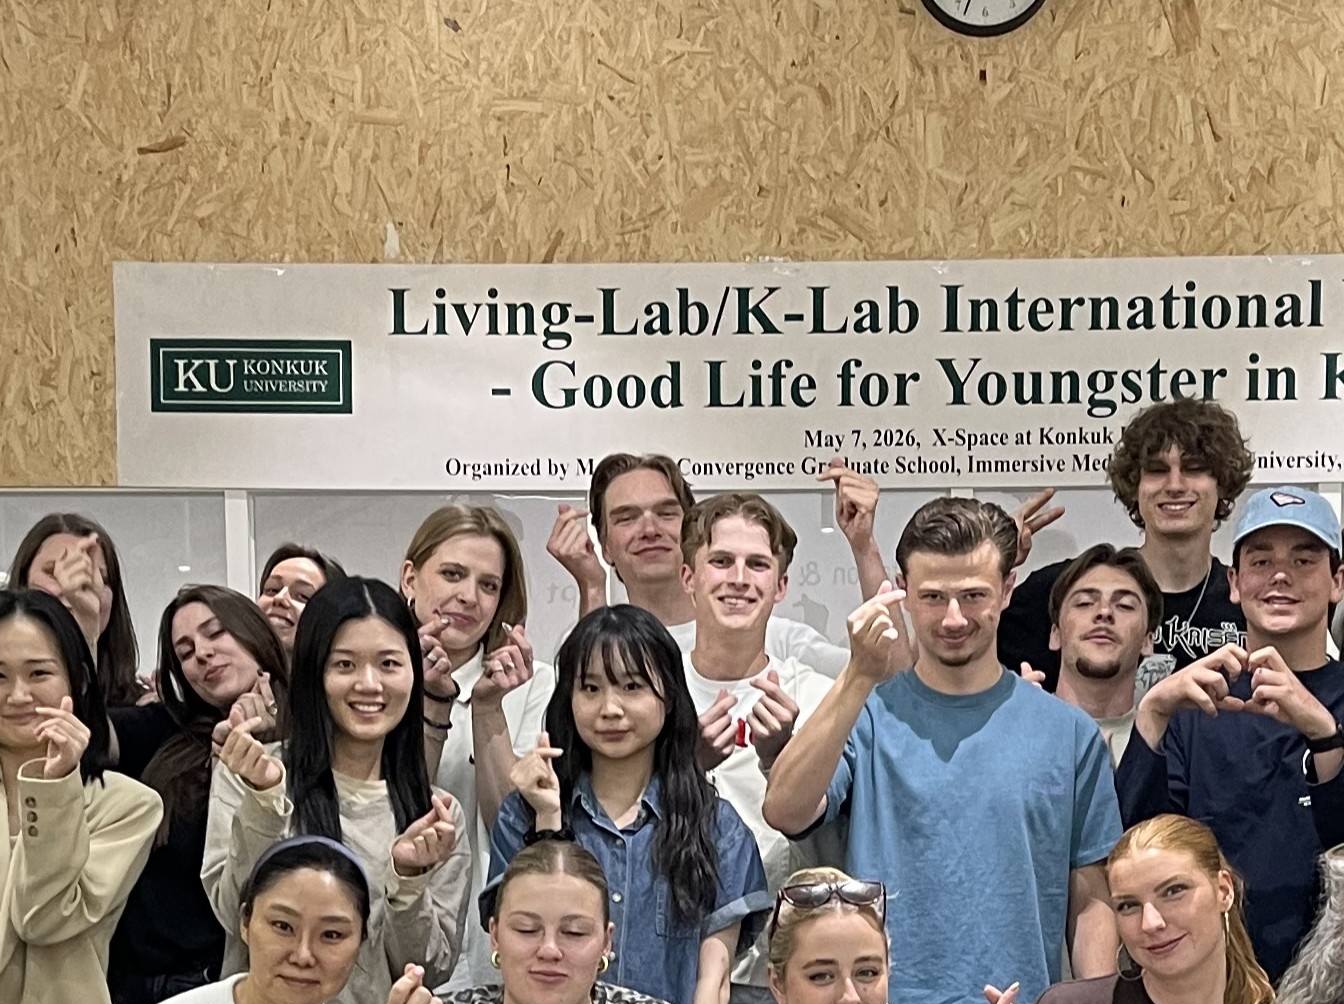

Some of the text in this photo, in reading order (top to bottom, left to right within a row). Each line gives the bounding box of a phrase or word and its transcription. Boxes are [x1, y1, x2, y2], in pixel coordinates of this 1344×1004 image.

[387, 285, 920, 350] Living-Lab/K-Lab
[939, 279, 1325, 333] International
[173, 359, 238, 393] KU
[243, 359, 328, 376] KONKUK
[243, 380, 328, 393] UNIVERSITY
[530, 358, 685, 409] Good
[703, 358, 818, 408] Life
[836, 358, 921, 407] for
[935, 356, 1228, 419] Youngster
[1244, 352, 1298, 402] in
[804, 429, 846, 452] May
[851, 429, 867, 450] 7,
[872, 428, 921, 450] 2026,
[932, 427, 1009, 452] X-Space
[1014, 428, 1032, 446] at
[1039, 426, 1114, 445] Konkuk
[445, 457, 541, 481] Organized
[547, 457, 569, 480] by
[676, 456, 795, 481] Convergence
[801, 456, 890, 476] Gruate
[895, 455, 962, 476] School,
[967, 454, 1066, 474] Immersive
[1254, 450, 1342, 472] niversity,
